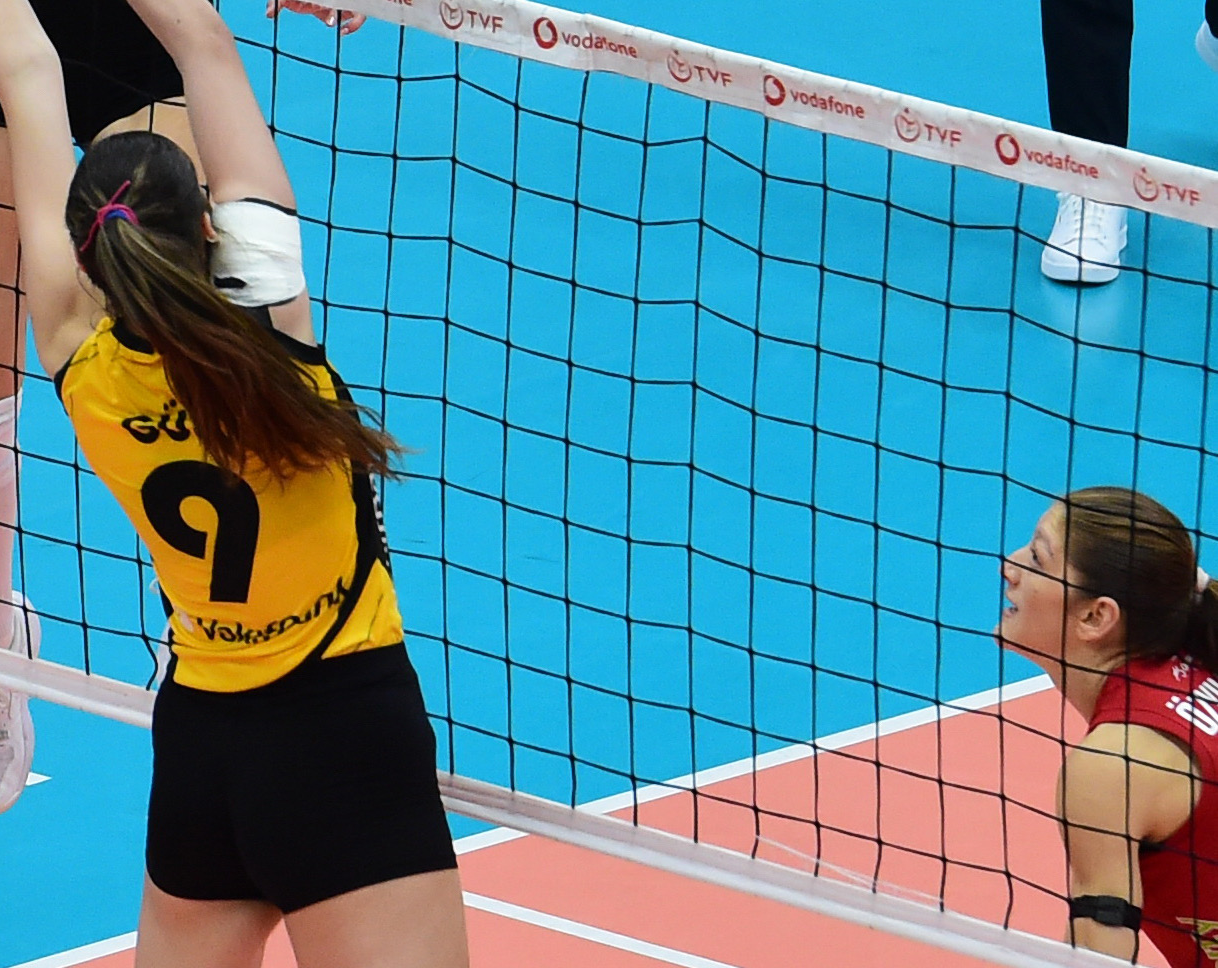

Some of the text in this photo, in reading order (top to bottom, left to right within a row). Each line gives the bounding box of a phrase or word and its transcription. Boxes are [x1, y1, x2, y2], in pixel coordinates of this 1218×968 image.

[466, 10, 504, 34] TVF
[561, 30, 638, 59] vodafone
[693, 65, 733, 88] TVF
[790, 88, 866, 120] vodafone
[924, 123, 963, 148] TVF
[1024, 148, 1099, 180] vodafone
[1162, 182, 1201, 206] TVF
[121, 399, 191, 444] GÜ
[140, 459, 260, 603] 9
